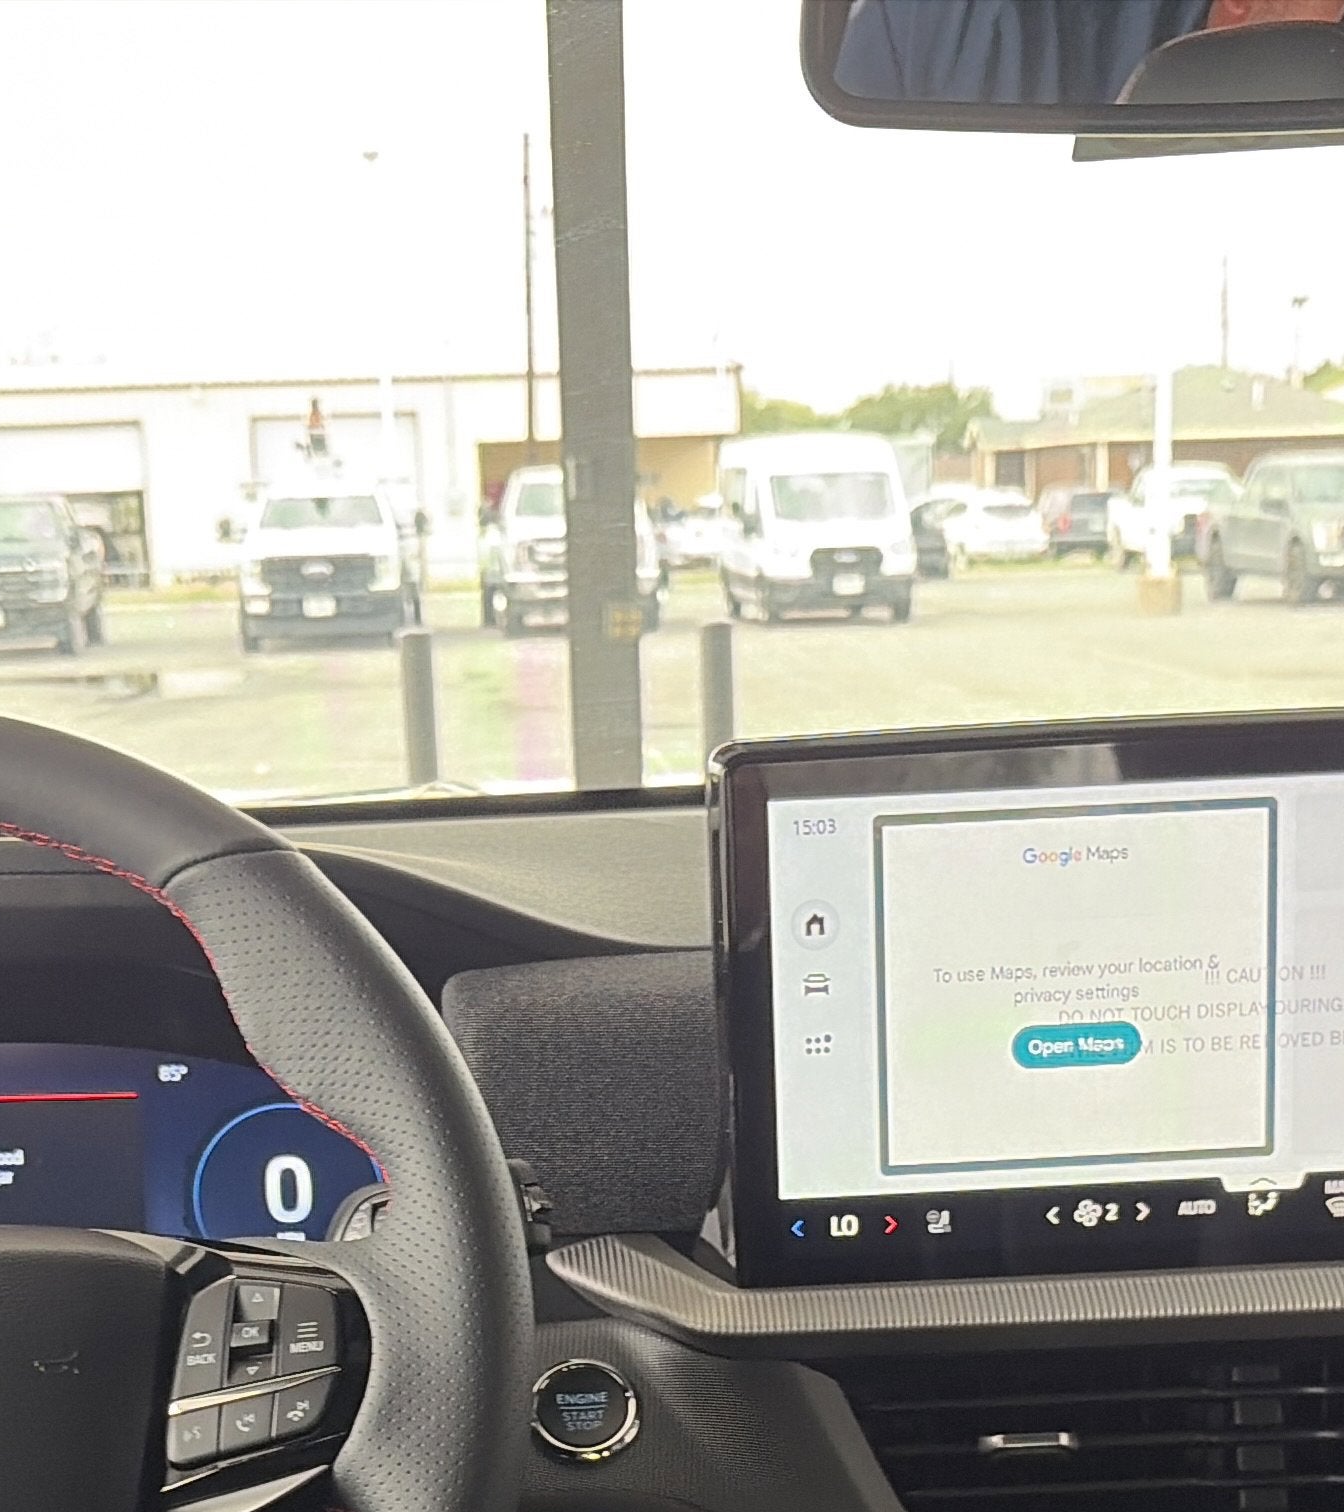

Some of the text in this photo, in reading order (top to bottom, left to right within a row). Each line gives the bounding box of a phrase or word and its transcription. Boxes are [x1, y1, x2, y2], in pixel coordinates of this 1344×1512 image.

[793, 819, 837, 835] 15:03
[1023, 846, 1129, 866] Google Maps
[933, 955, 1219, 984] To use Maps, review your location &
[1226, 965, 1304, 984] CAUON
[1014, 984, 1140, 1007] privacy settings
[1131, 1003, 1190, 1021] TOUCH
[1275, 997, 1343, 1016] DURING
[1027, 1038, 1074, 1058] Open
[1161, 1038, 1176, 1053] IS
[1183, 1037, 1205, 1053] TO
[1211, 1035, 1234, 1051] BE
[1239, 1032, 1324, 1050] REOVED
[264, 1154, 313, 1224] 0
[1104, 1203, 1120, 1222] 2
[1177, 1199, 1217, 1216] AUTO
[829, 1213, 861, 1238] LO
[241, 1326, 260, 1339] OK
[289, 1341, 324, 1354] MENU
[186, 1353, 216, 1366] BACK
[556, 1391, 608, 1405] ENGINE
[561, 1410, 605, 1422] START
[566, 1421, 603, 1432] STOP
